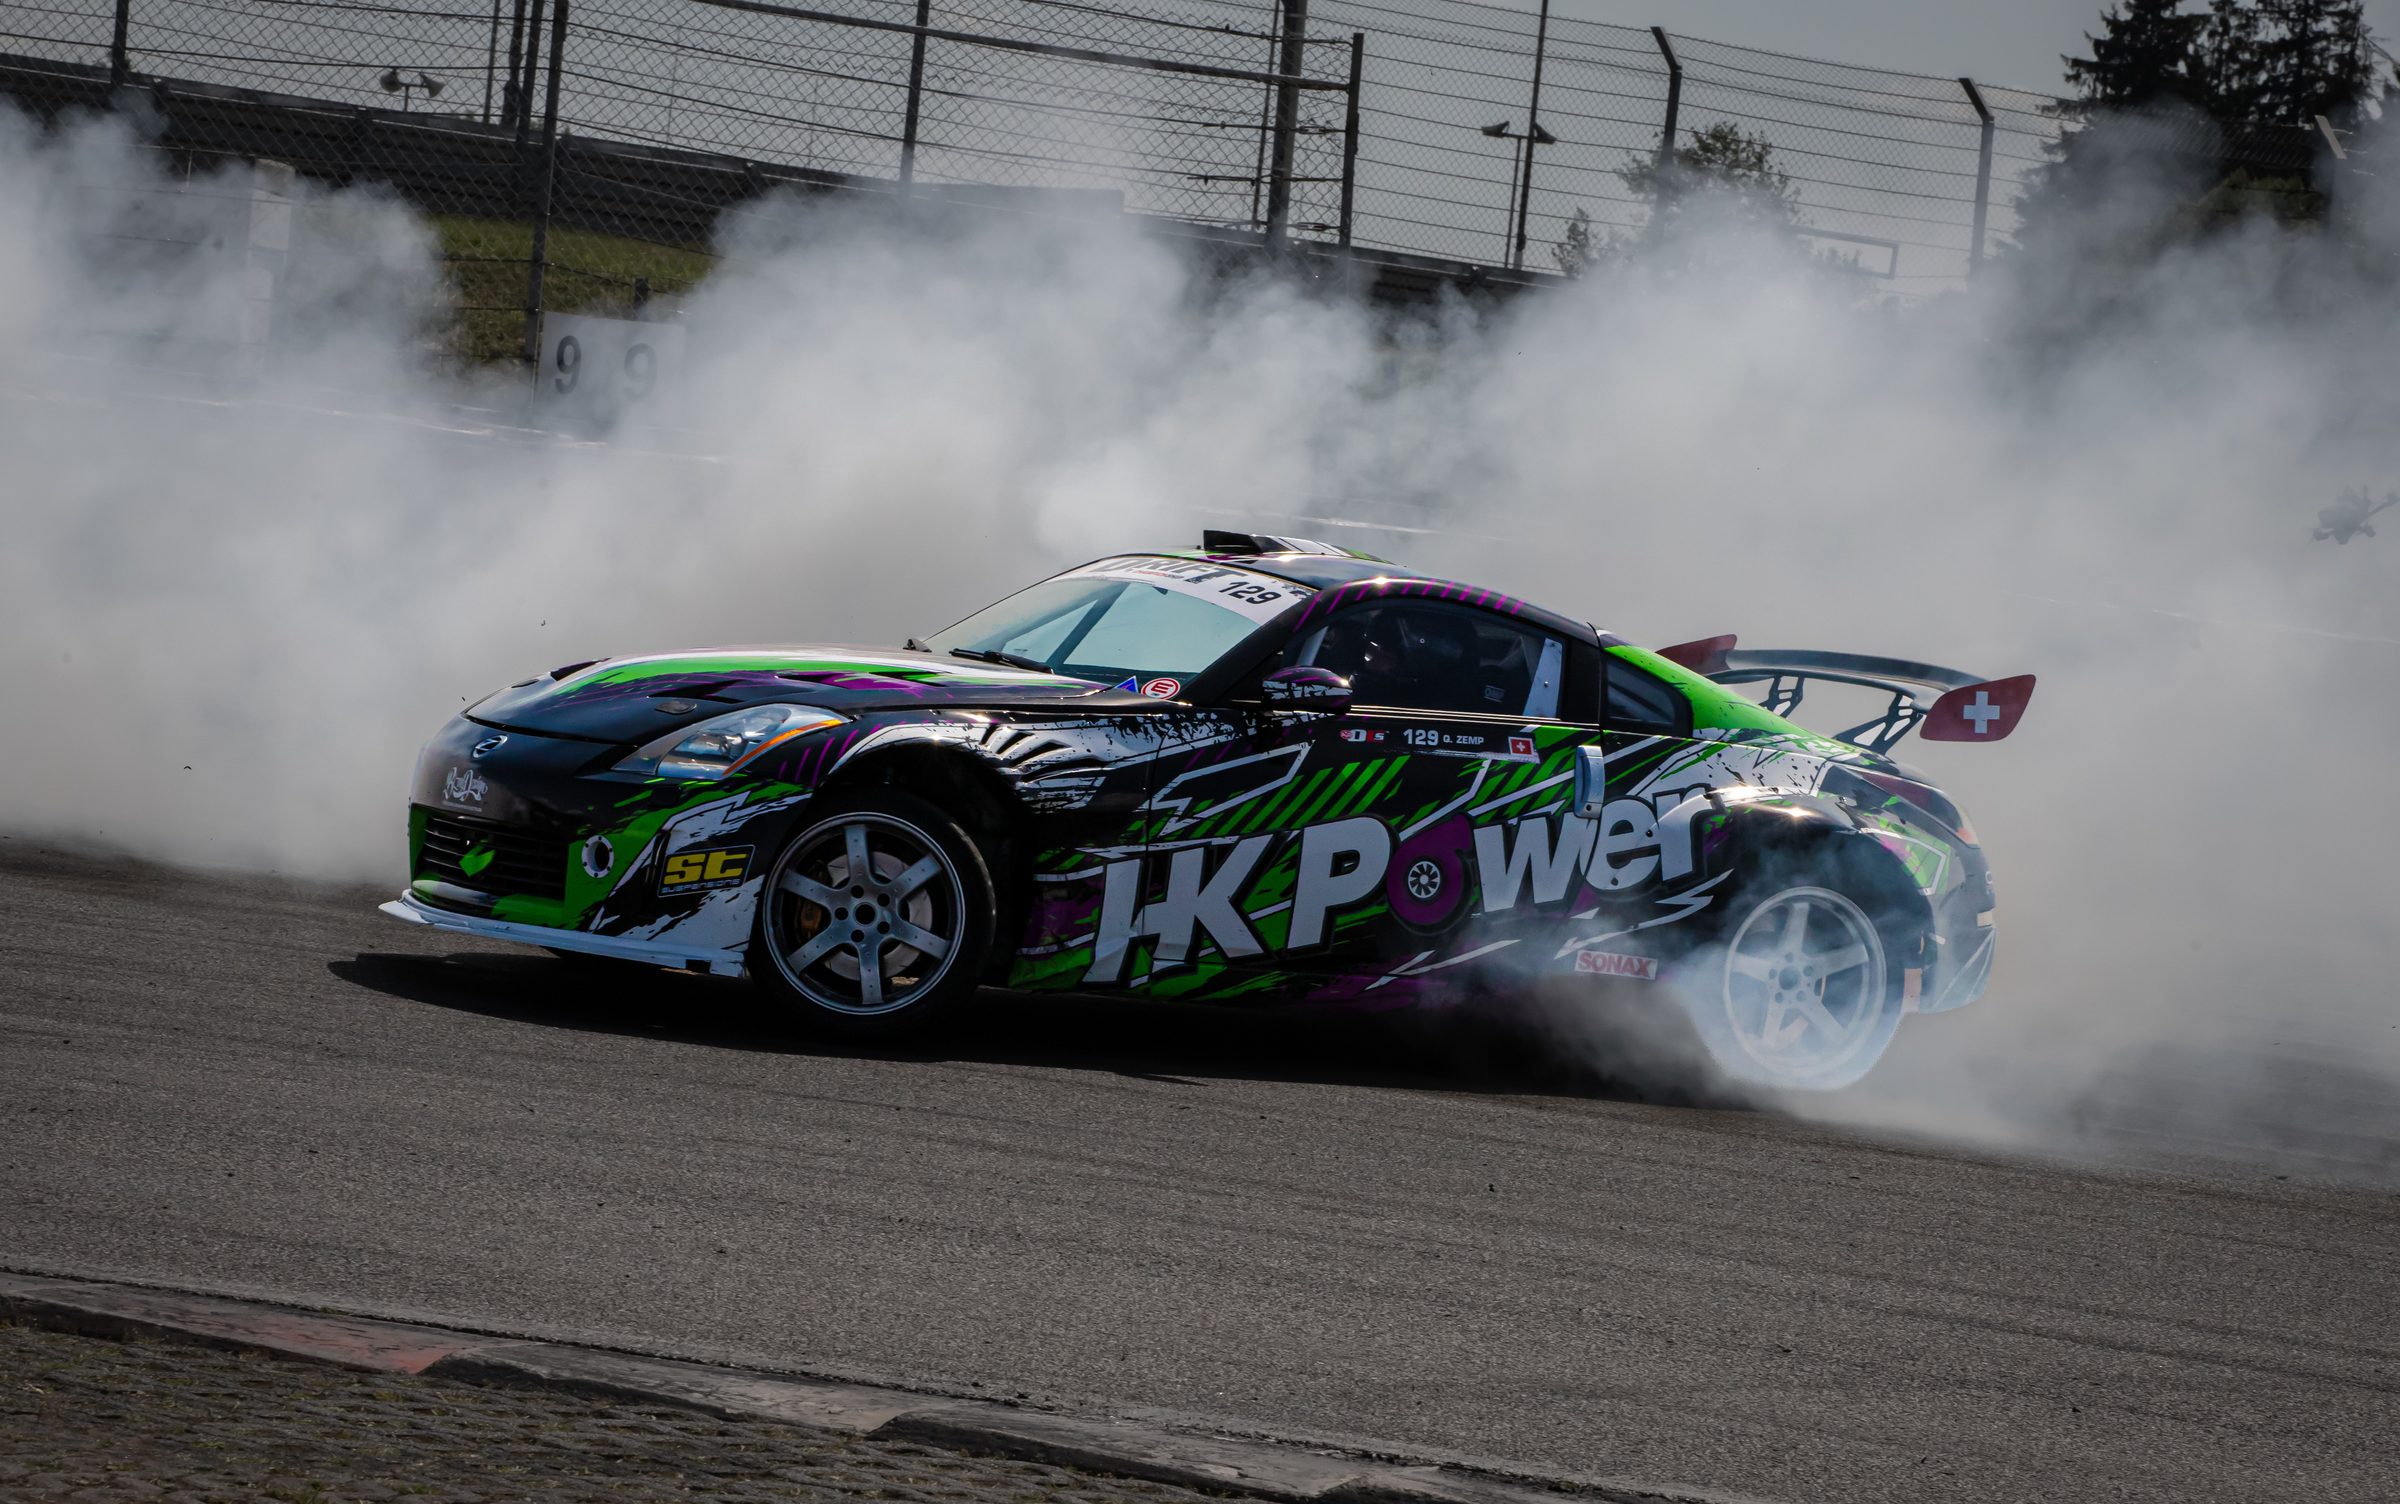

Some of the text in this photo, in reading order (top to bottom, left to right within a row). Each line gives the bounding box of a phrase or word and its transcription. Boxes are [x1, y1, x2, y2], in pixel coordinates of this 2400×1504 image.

[555, 335, 657, 397] 9 9
[1089, 558, 1249, 585] DRIFT
[1219, 580, 1282, 605] 129
[1403, 729, 1439, 746] 129
[1456, 735, 1484, 745] ZEMP
[1579, 952, 1656, 977] SONAX
